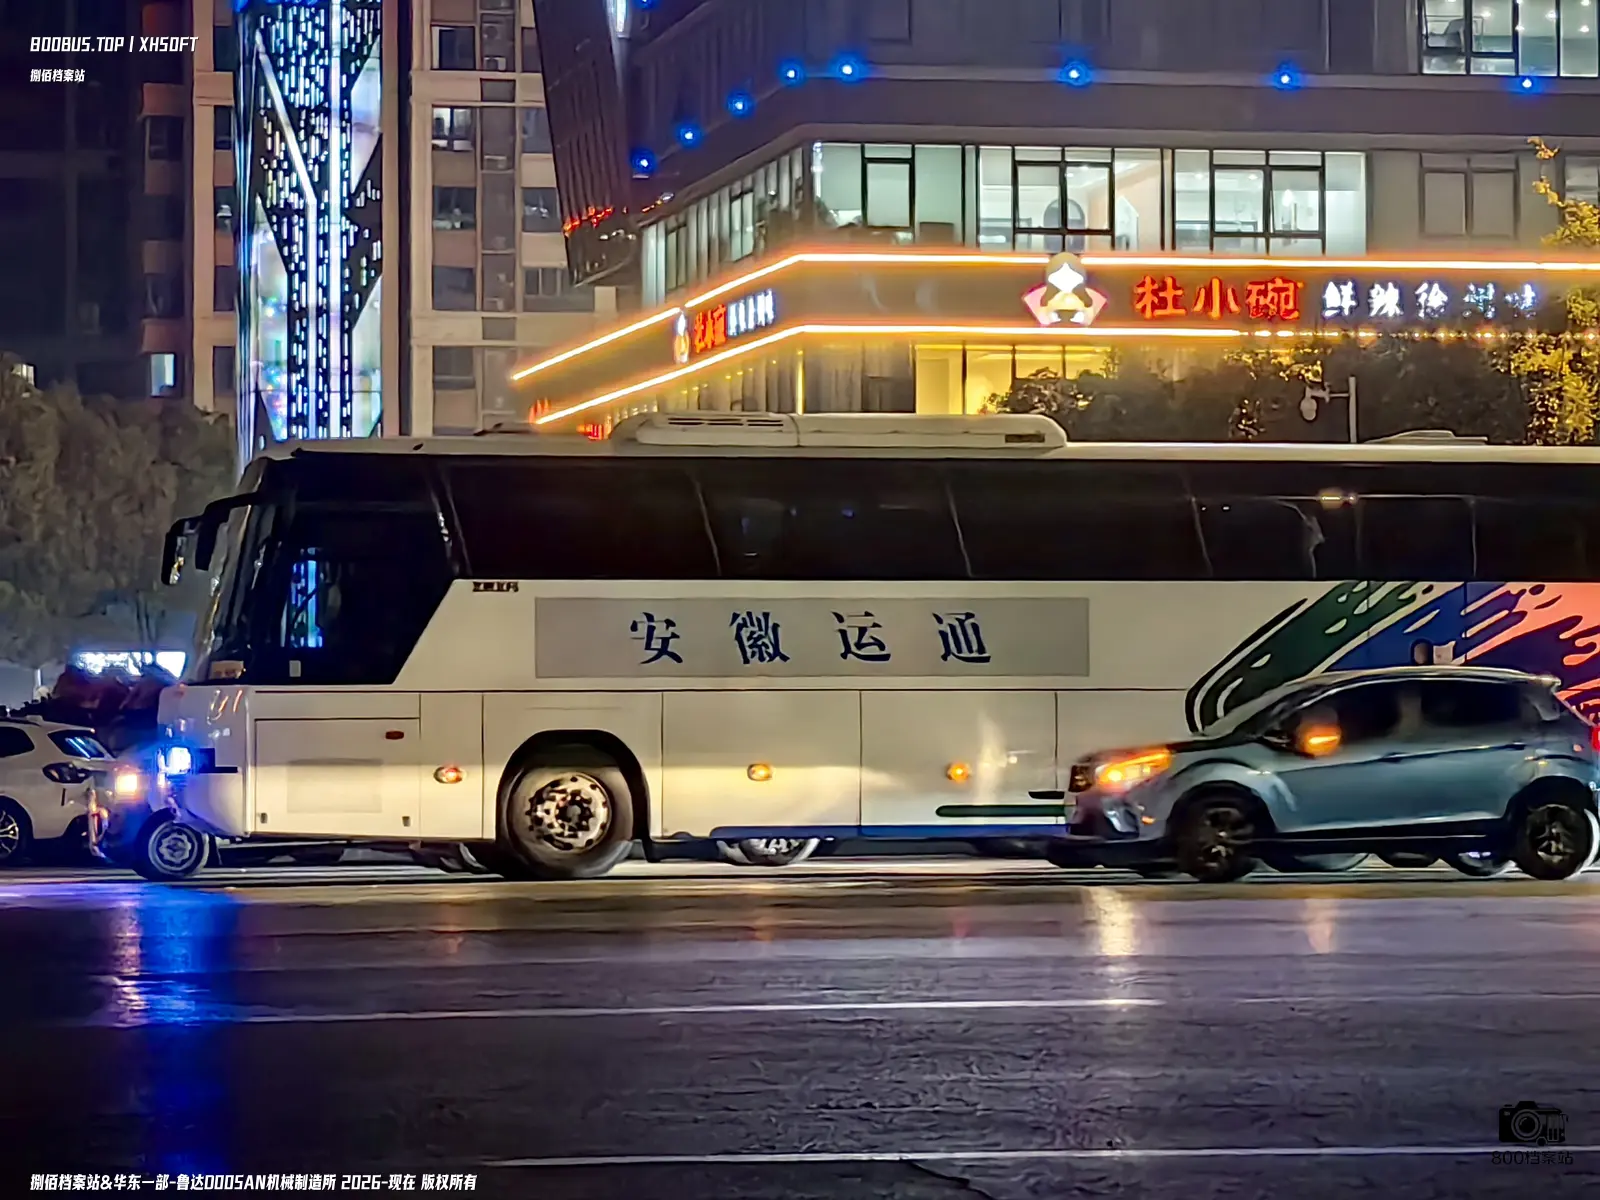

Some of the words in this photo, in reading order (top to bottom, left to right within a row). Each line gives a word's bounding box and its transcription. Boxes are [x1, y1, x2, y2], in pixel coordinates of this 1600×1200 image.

[1134, 275, 1301, 319] 杜小碗
[630, 611, 992, 665] 安徽运通
